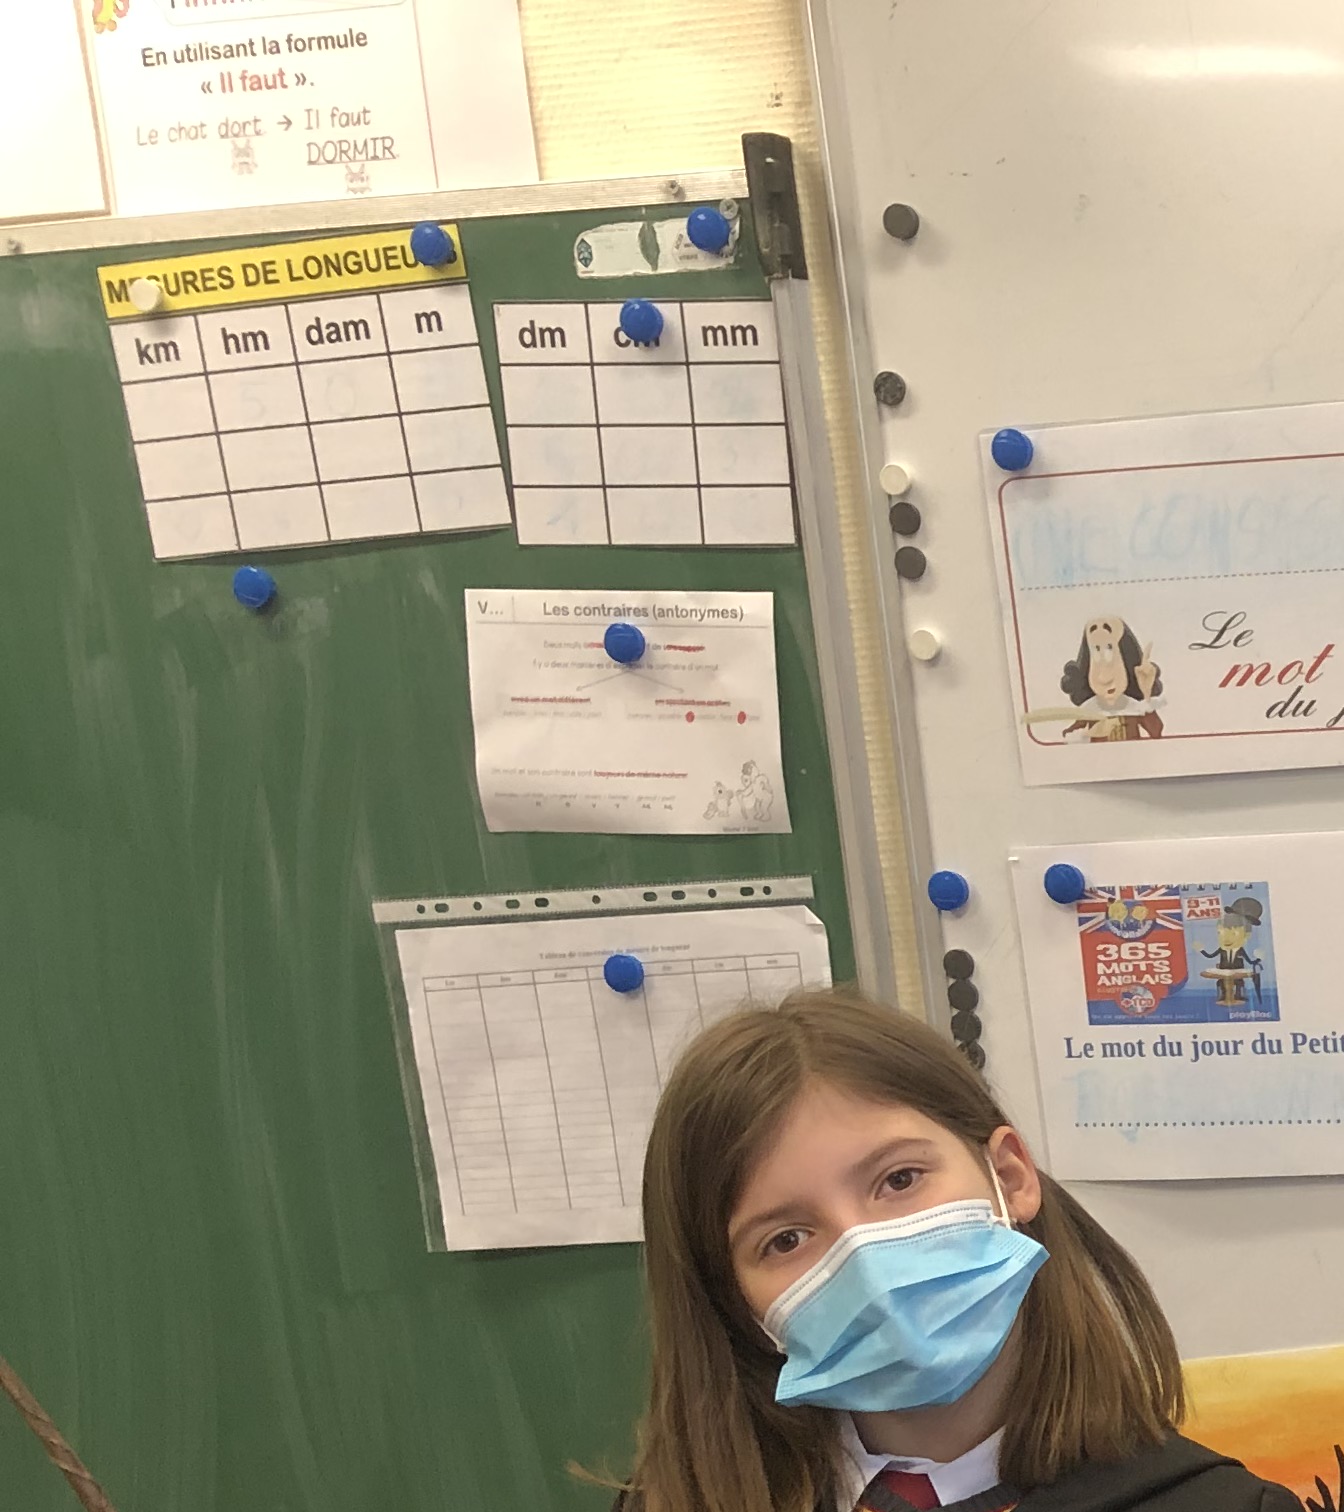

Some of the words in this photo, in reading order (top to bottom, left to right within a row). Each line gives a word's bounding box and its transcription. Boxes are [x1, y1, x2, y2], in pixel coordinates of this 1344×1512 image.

[141, 47, 168, 67] En
[173, 38, 257, 64] utilisant
[261, 36, 281, 55] la
[285, 27, 368, 53] formule
[238, 67, 288, 92] faut
[137, 125, 159, 146] Le
[168, 121, 207, 143] chat
[218, 116, 262, 139] dort
[330, 106, 371, 128] faut
[306, 135, 397, 165] DORMIR
[105, 266, 235, 304] MURES
[241, 260, 280, 288] DE
[286, 243, 458, 283] LONGUEU
[135, 338, 181, 366] km
[221, 327, 270, 355] hm
[305, 316, 371, 346] dam
[414, 310, 443, 334] m
[518, 320, 567, 348] dm
[701, 323, 759, 348] mm
[543, 601, 570, 617] Les
[574, 603, 649, 619] contraires
[652, 604, 745, 622] (antonymes)
[1188, 610, 1254, 650] Le
[1218, 643, 1335, 688] mot
[1265, 685, 1317, 719] du
[1186, 907, 1221, 919] ANS
[1096, 942, 1172, 961] 365
[1097, 960, 1171, 976] MOTS
[1097, 974, 1173, 987] ANGLAIS
[1064, 1037, 1095, 1058] Le
[1101, 1039, 1146, 1058] mot
[1153, 1035, 1183, 1057] du
[1190, 1034, 1243, 1062] jour
[1251, 1032, 1283, 1055] du
